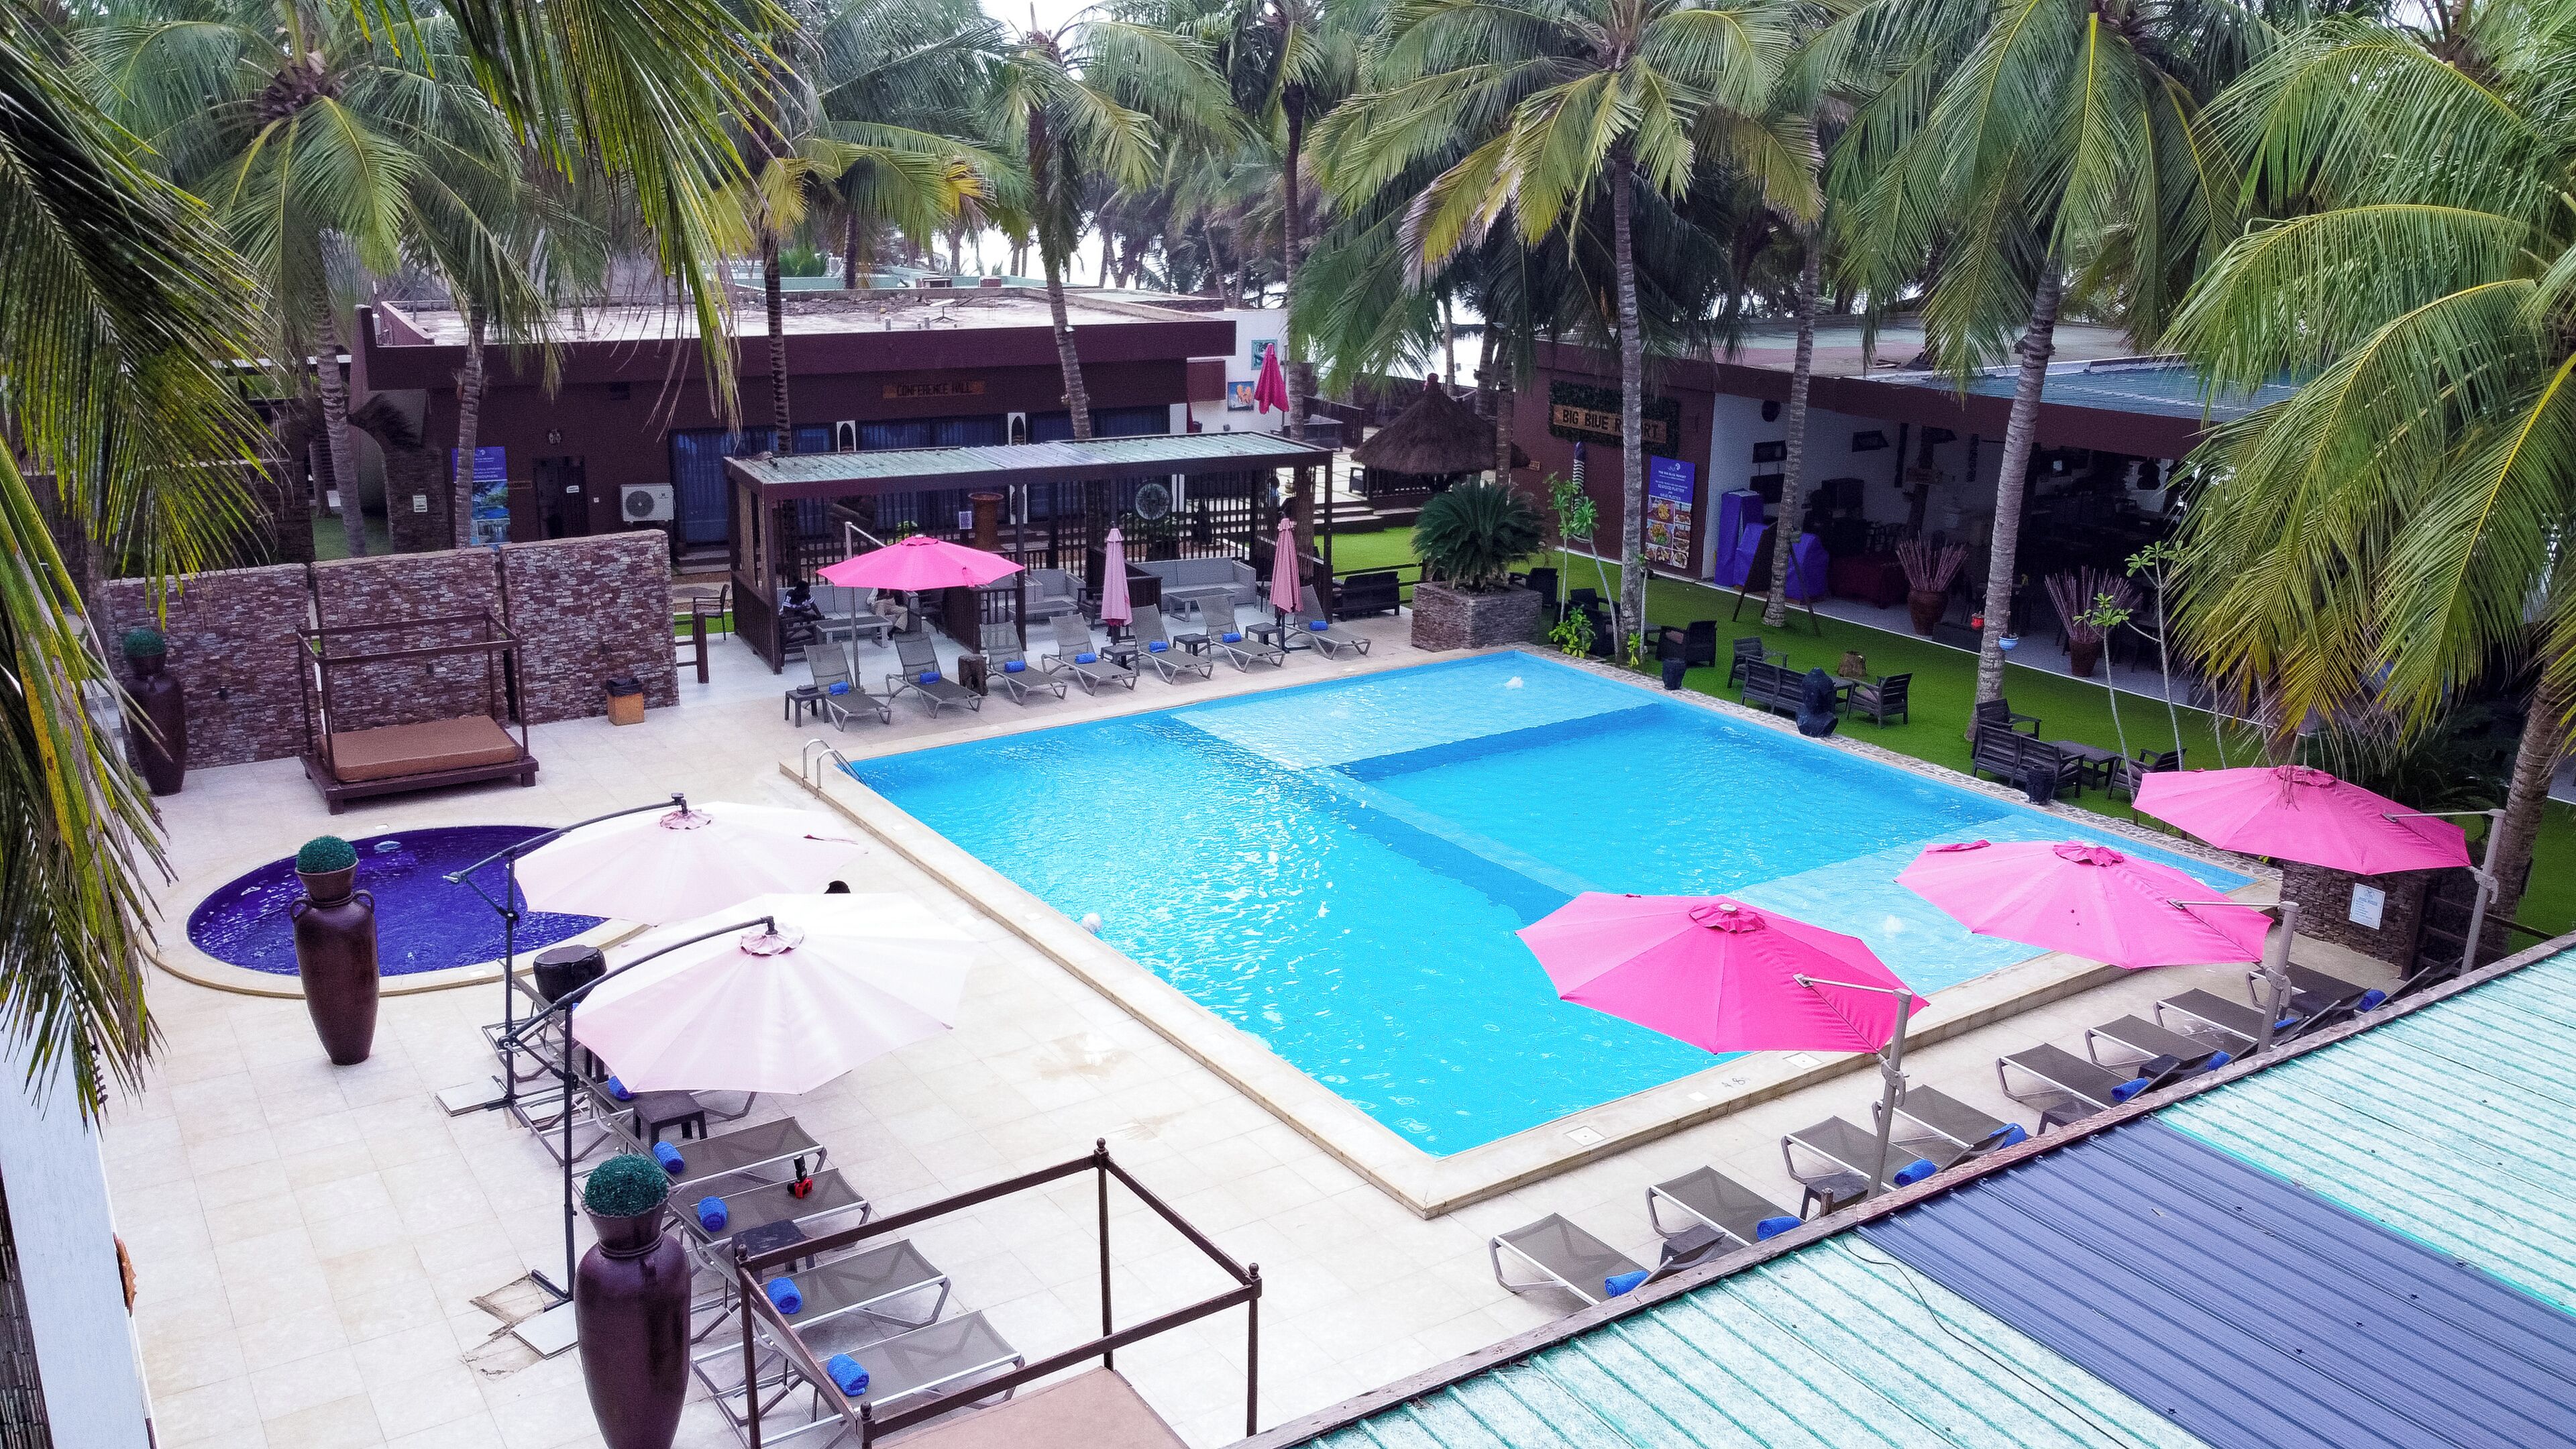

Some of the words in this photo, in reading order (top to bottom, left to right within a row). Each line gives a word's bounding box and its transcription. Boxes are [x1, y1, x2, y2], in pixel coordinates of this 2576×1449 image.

[1562, 409, 1579, 425] BIG
[1585, 413, 1609, 430] BLUE
[1615, 418, 1658, 438] RRT
